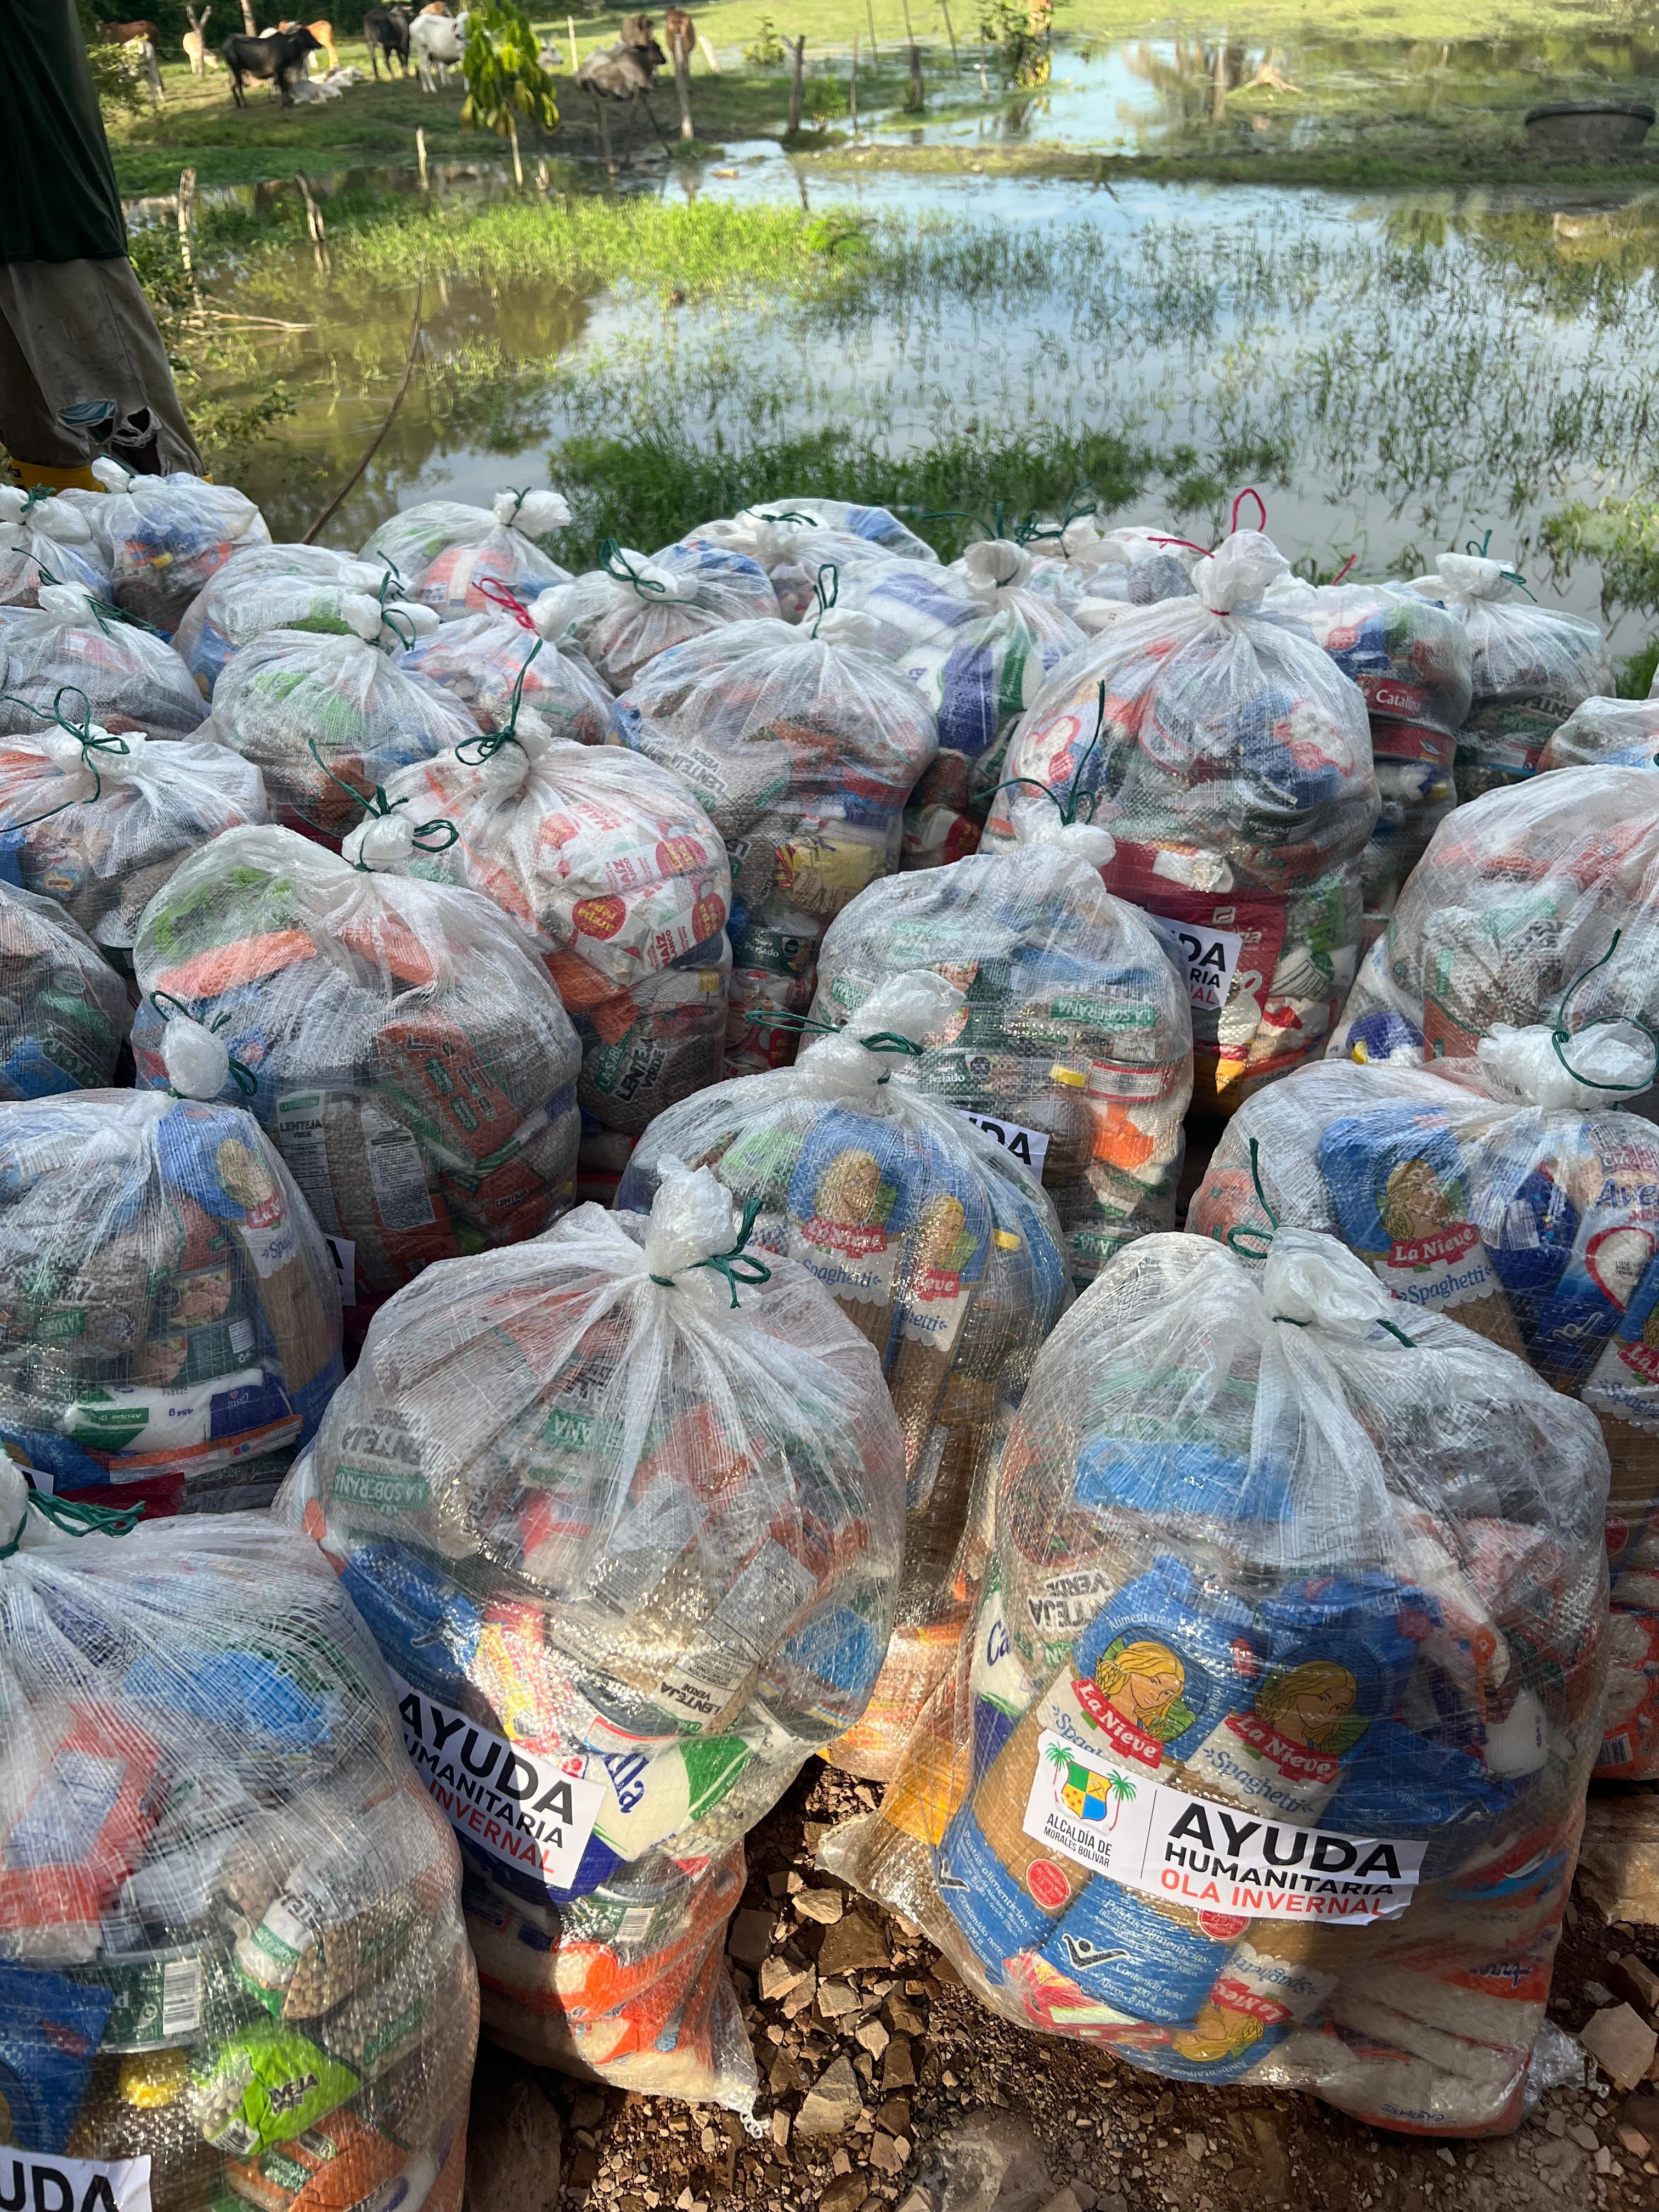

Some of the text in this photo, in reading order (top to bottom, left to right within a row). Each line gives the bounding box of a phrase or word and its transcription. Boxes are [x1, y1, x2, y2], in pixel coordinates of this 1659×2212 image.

[1375, 689, 1421, 713] Catalina
[279, 1119, 323, 1132] LENTEJA
[1395, 1227, 1474, 1261] La Nieve
[1408, 1265, 1486, 1306] Spaghetti
[1627, 1345, 1652, 1370] La
[177, 1408, 193, 1417] 454
[1107, 1612, 1178, 1632] Alimentamos
[660, 1680, 722, 1716] LENTEJA
[681, 1683, 711, 1701] VERDE
[1079, 1682, 1158, 1758] La Nieve
[399, 1692, 573, 1825] AYUDA
[1237, 1715, 1331, 1775] La Nieve
[404, 1733, 563, 1849] UMANITARIA
[1210, 1751, 1307, 1813] Spaghetti
[1043, 1826, 1110, 1868] MORALES BOLÍVAR
[1046, 1812, 1113, 1857] ALCALDÍA DE
[1168, 1802, 1402, 1879] AYUDA
[964, 1830, 983, 1866] Pastas
[981, 1867, 1030, 1929] alimenticias
[1164, 1841, 1393, 1896] HUMANITARIA
[1160, 1867, 1384, 1917] OLA INVERNAL
[958, 1893, 989, 1937] Contenido
[966, 1922, 979, 1938] 500
[1103, 1898, 1141, 1929] Pastas
[1115, 1962, 1162, 1992] Contenido
[1132, 1985, 1151, 1998] 500
[1134, 1998, 1179, 2022] porciones
